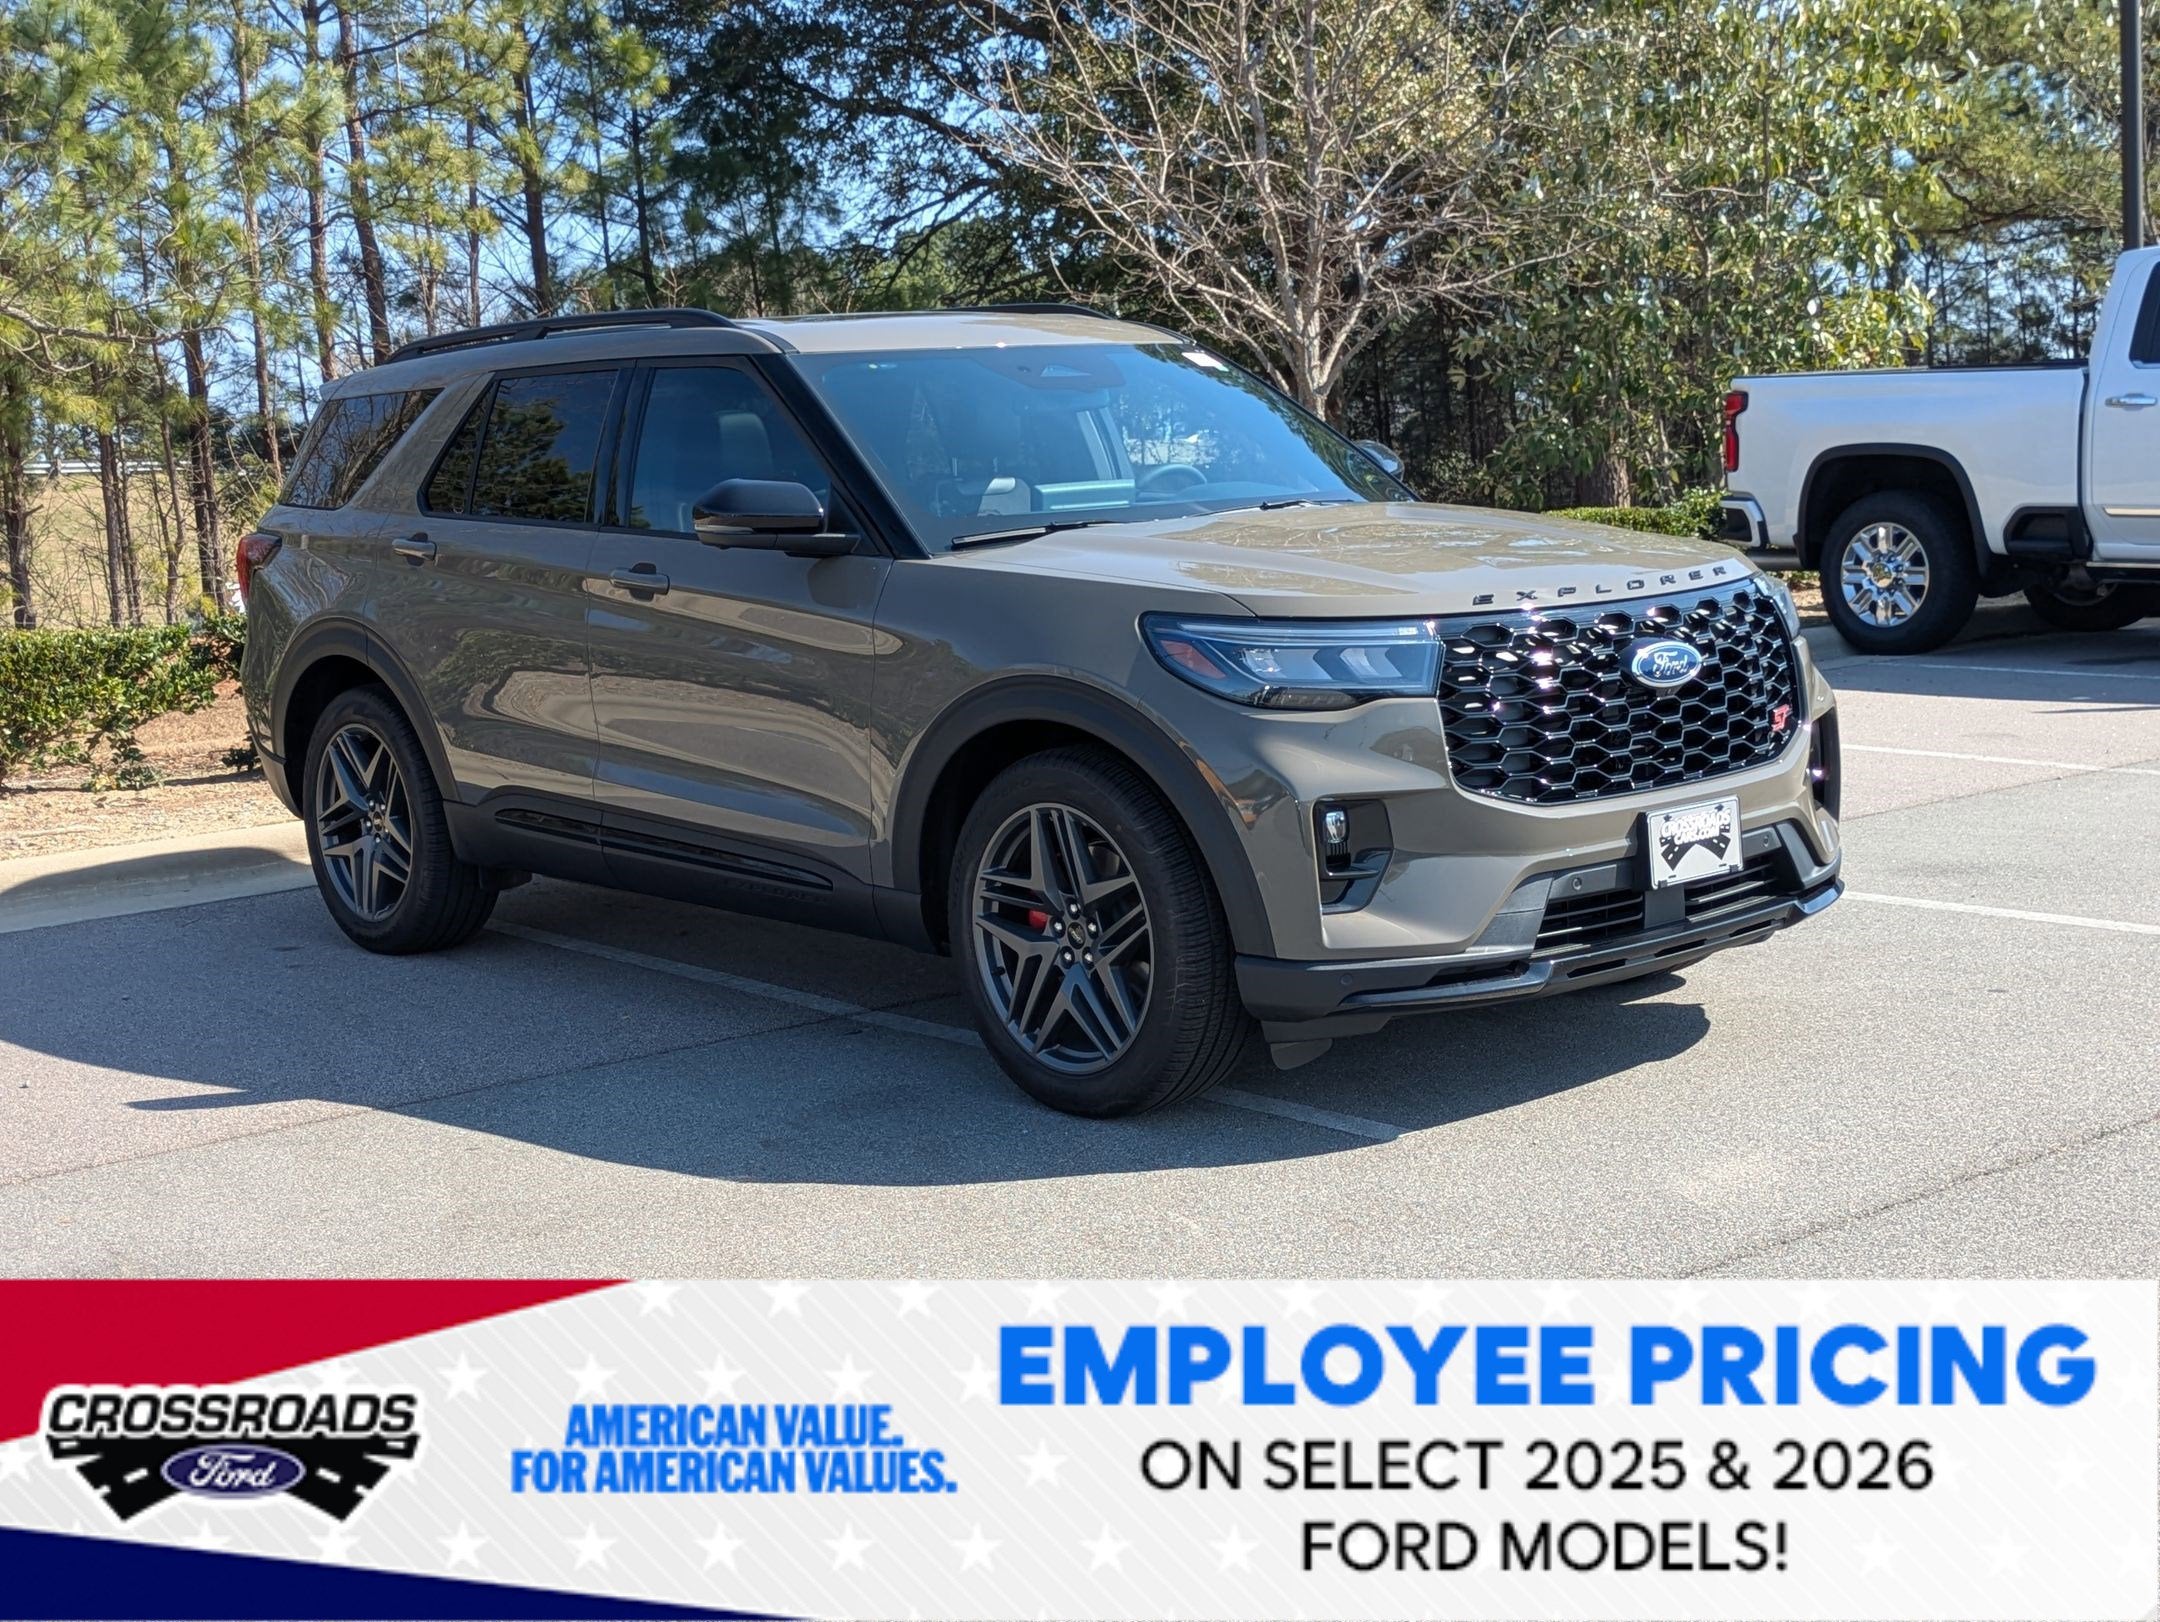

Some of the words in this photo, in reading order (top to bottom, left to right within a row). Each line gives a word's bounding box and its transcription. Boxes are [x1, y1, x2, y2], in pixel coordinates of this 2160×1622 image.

[1472, 565, 1727, 606] EXPLORER
[1652, 650, 1690, 678] Ford
[1660, 809, 1732, 838] CROSSROADS
